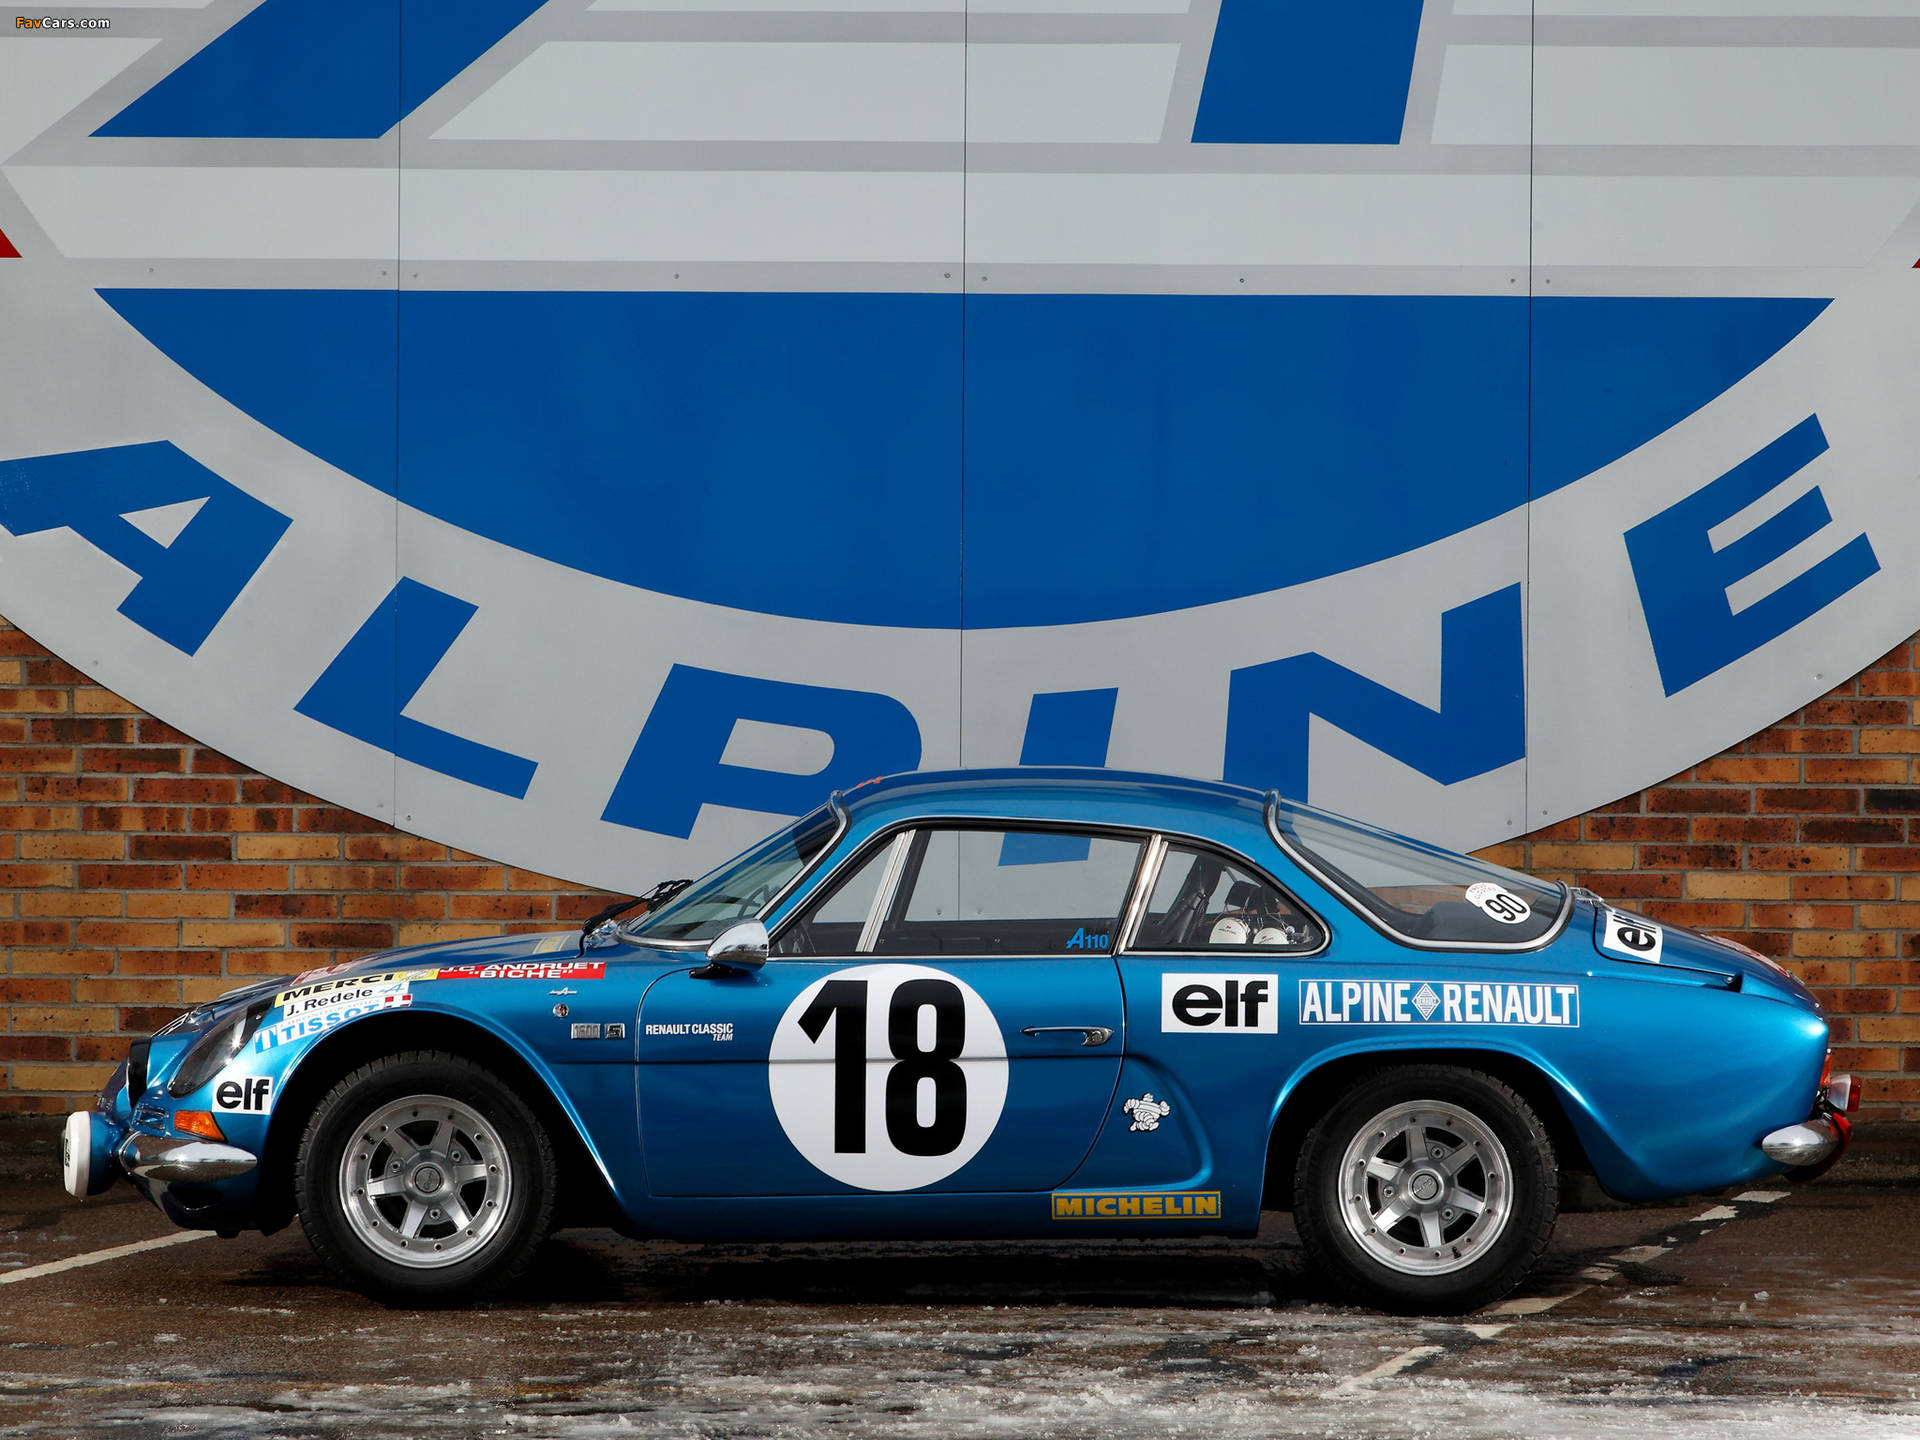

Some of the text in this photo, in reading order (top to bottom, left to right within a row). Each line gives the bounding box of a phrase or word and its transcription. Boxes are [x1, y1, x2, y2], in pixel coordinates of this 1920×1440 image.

[0, 412, 1880, 868] ALPINE
[1485, 893, 1527, 921] 90
[1066, 928, 1109, 949] A110
[484, 962, 605, 971] ANDRUET
[282, 974, 394, 1002] MERCI
[286, 1004, 299, 1017] J.
[303, 988, 373, 1011] Redele
[1172, 980, 1268, 1027] elf
[1302, 982, 1575, 1024] ALPINE RENAULT
[281, 1003, 380, 1041] TISSOT
[645, 1022, 734, 1035] RENAULT CLASSIC
[712, 1033, 733, 1041] TEAM
[797, 978, 967, 1157] 18
[216, 1079, 269, 1110] elf
[1055, 1196, 1217, 1216] MICHELIN
